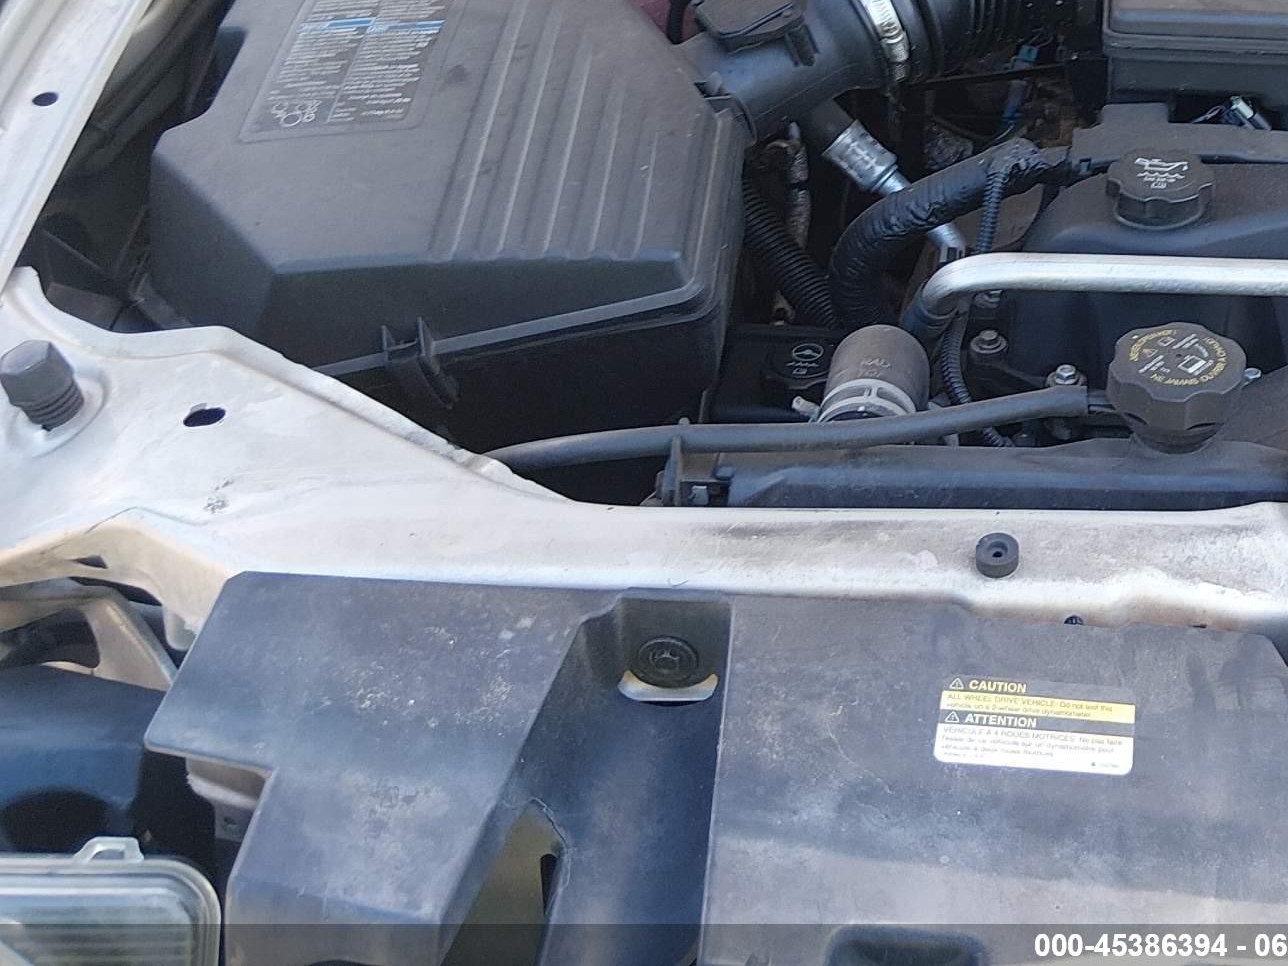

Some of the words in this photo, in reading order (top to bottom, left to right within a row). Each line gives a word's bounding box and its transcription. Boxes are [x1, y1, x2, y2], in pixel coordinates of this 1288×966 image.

[969, 680, 1027, 693] CAUTION
[995, 696, 1020, 704] DRIVE
[1060, 701, 1071, 709] Do
[964, 713, 1037, 728] ATTENTION
[1000, 730, 1030, 738] ROUES
